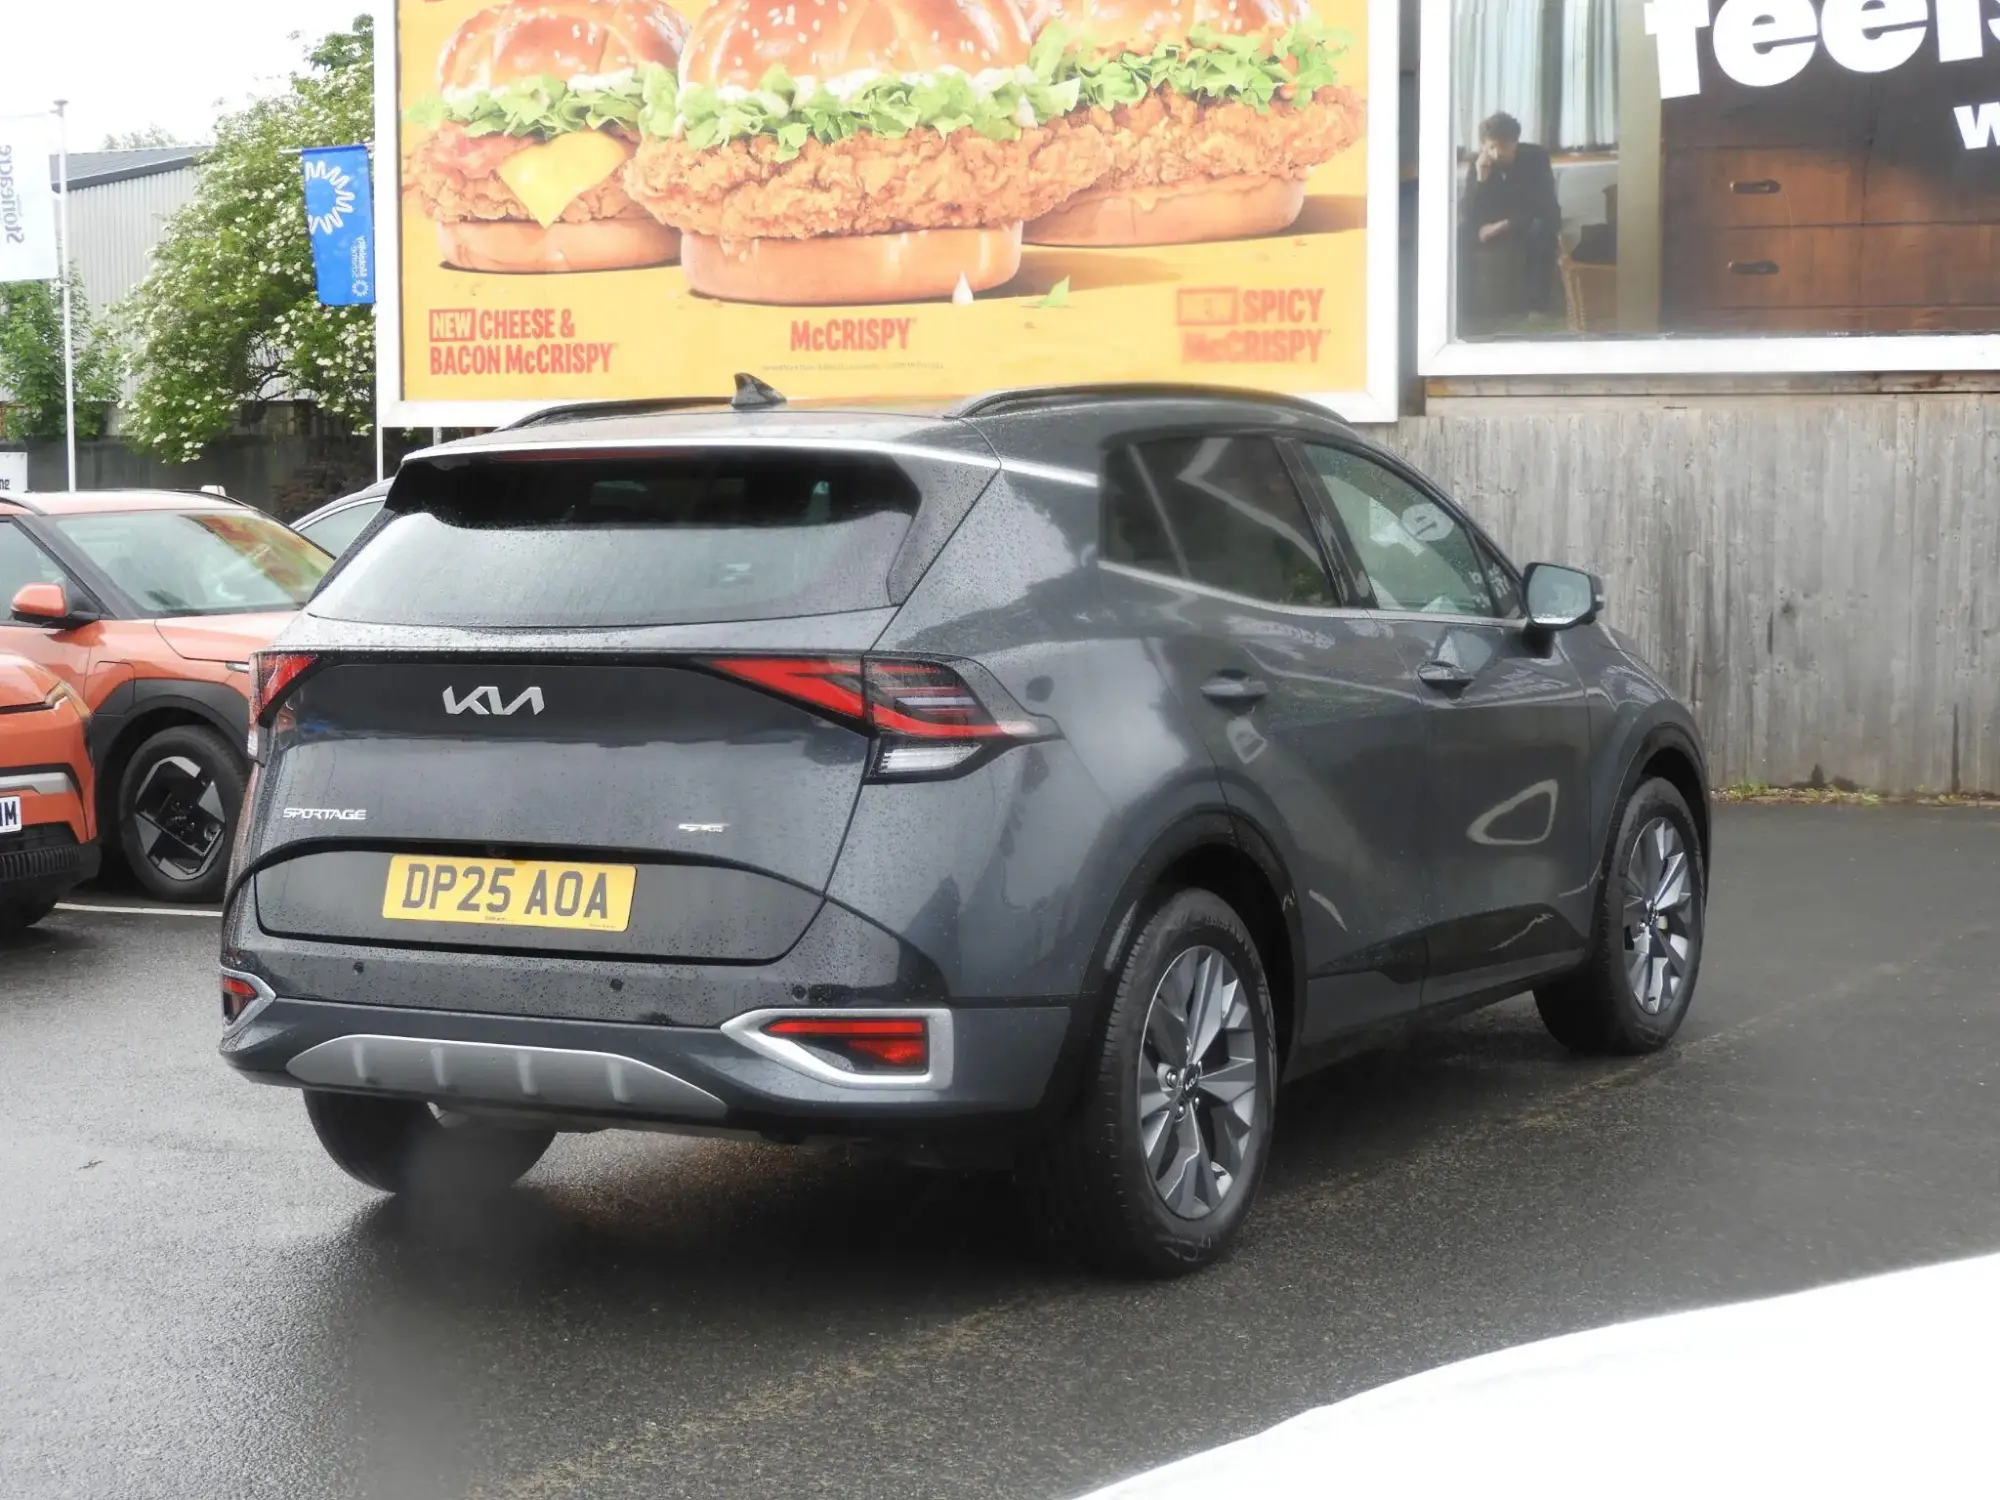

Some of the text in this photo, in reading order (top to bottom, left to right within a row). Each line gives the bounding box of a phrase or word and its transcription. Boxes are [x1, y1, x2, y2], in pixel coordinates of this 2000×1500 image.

[1242, 288, 1325, 323] SPICY
[432, 308, 576, 340] NEW CHEESE &
[791, 318, 911, 351] McCRISPY
[430, 343, 614, 376] BACON McCRISPY
[442, 685, 545, 716] KIA
[283, 807, 367, 820] SPORTAGE
[402, 863, 608, 919] DP25 AOA
